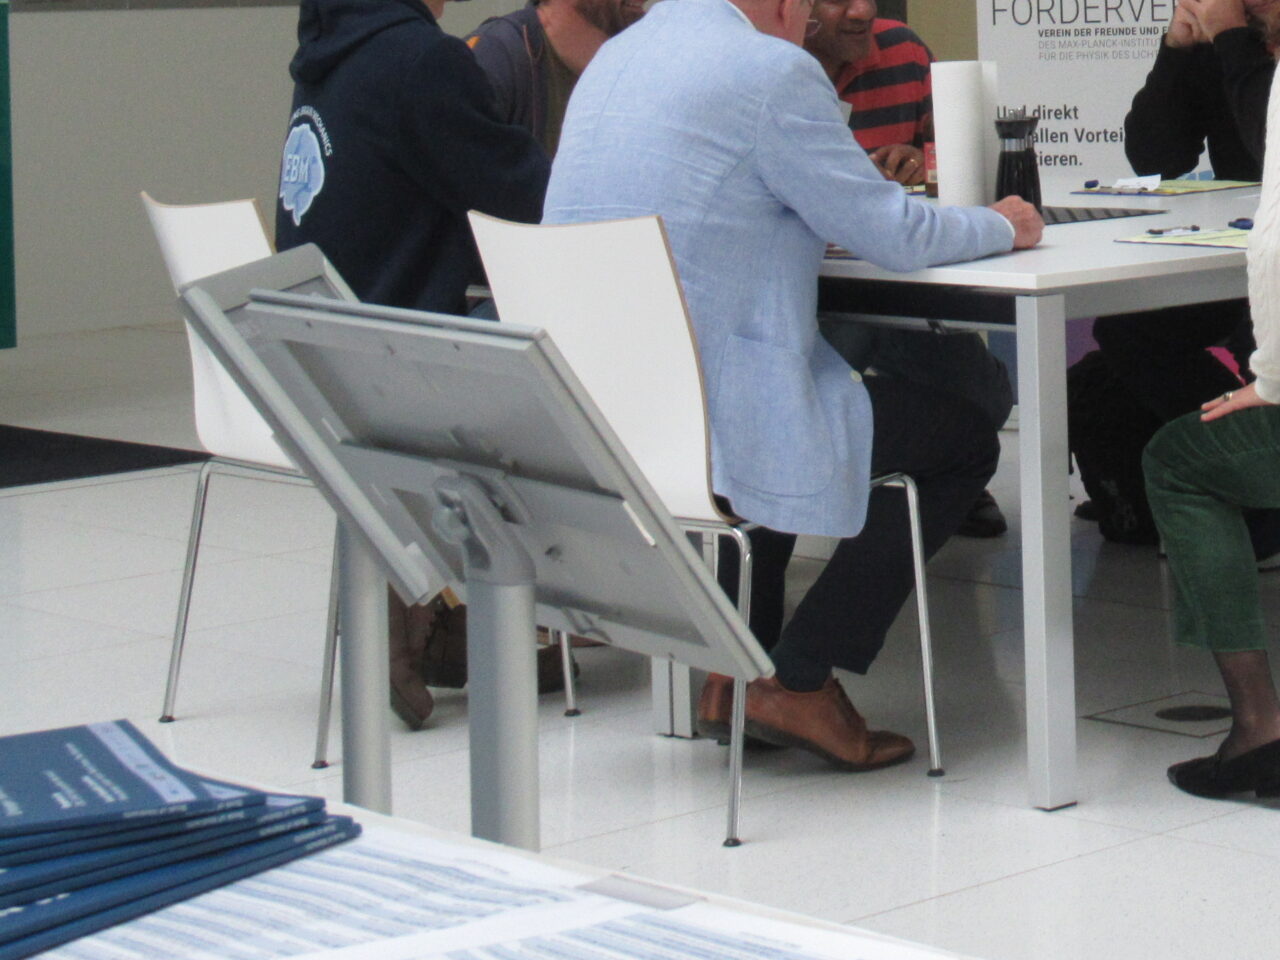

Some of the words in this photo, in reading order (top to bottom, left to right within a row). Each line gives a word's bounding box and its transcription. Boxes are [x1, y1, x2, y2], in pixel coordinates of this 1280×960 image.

[1038, 28, 1071, 38] VEREIN
[1074, 27, 1092, 37] DER
[1094, 26, 1137, 37] FREUNDE
[1139, 25, 1159, 35] UND
[1038, 40, 1056, 50] DES
[1059, 37, 1161, 49] MAX-PLANCK-INSTITU
[1059, 51, 1074, 61] DIE
[1076, 50, 1109, 60] PHYSIK
[1112, 50, 1130, 60] DES
[1032, 104, 1079, 120] direkt
[1033, 128, 1068, 143] allen
[1074, 127, 1124, 143] Vortei
